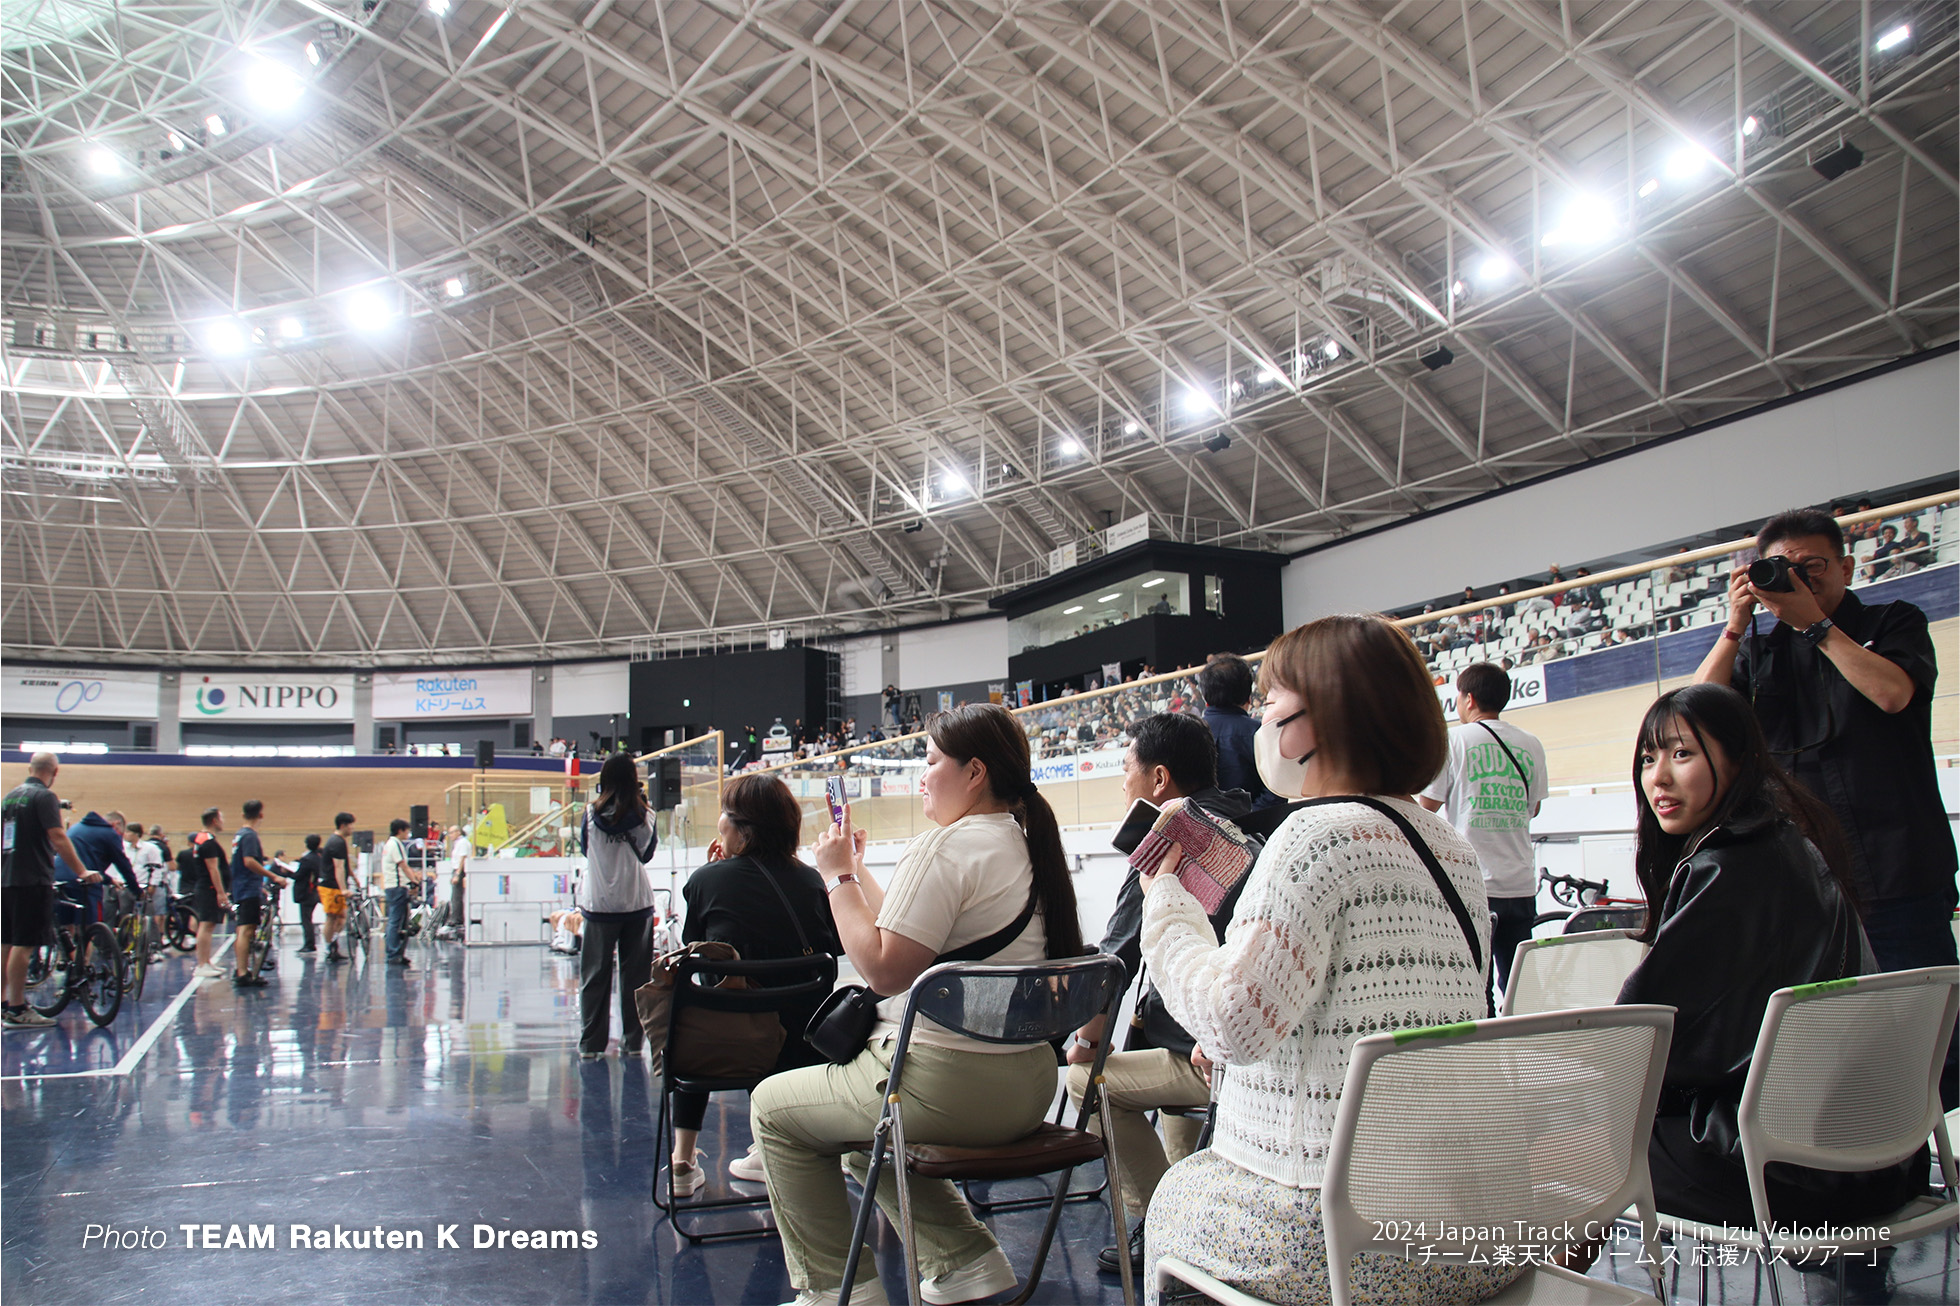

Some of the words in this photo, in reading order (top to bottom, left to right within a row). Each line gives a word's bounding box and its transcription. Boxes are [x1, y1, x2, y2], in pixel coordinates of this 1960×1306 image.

[20, 679, 60, 687] KEIRIN
[415, 677, 478, 693] Rakuten
[238, 685, 339, 709] NIPPO
[415, 696, 487, 713] Kドリームス
[1480, 782, 1525, 799] KYOTO
